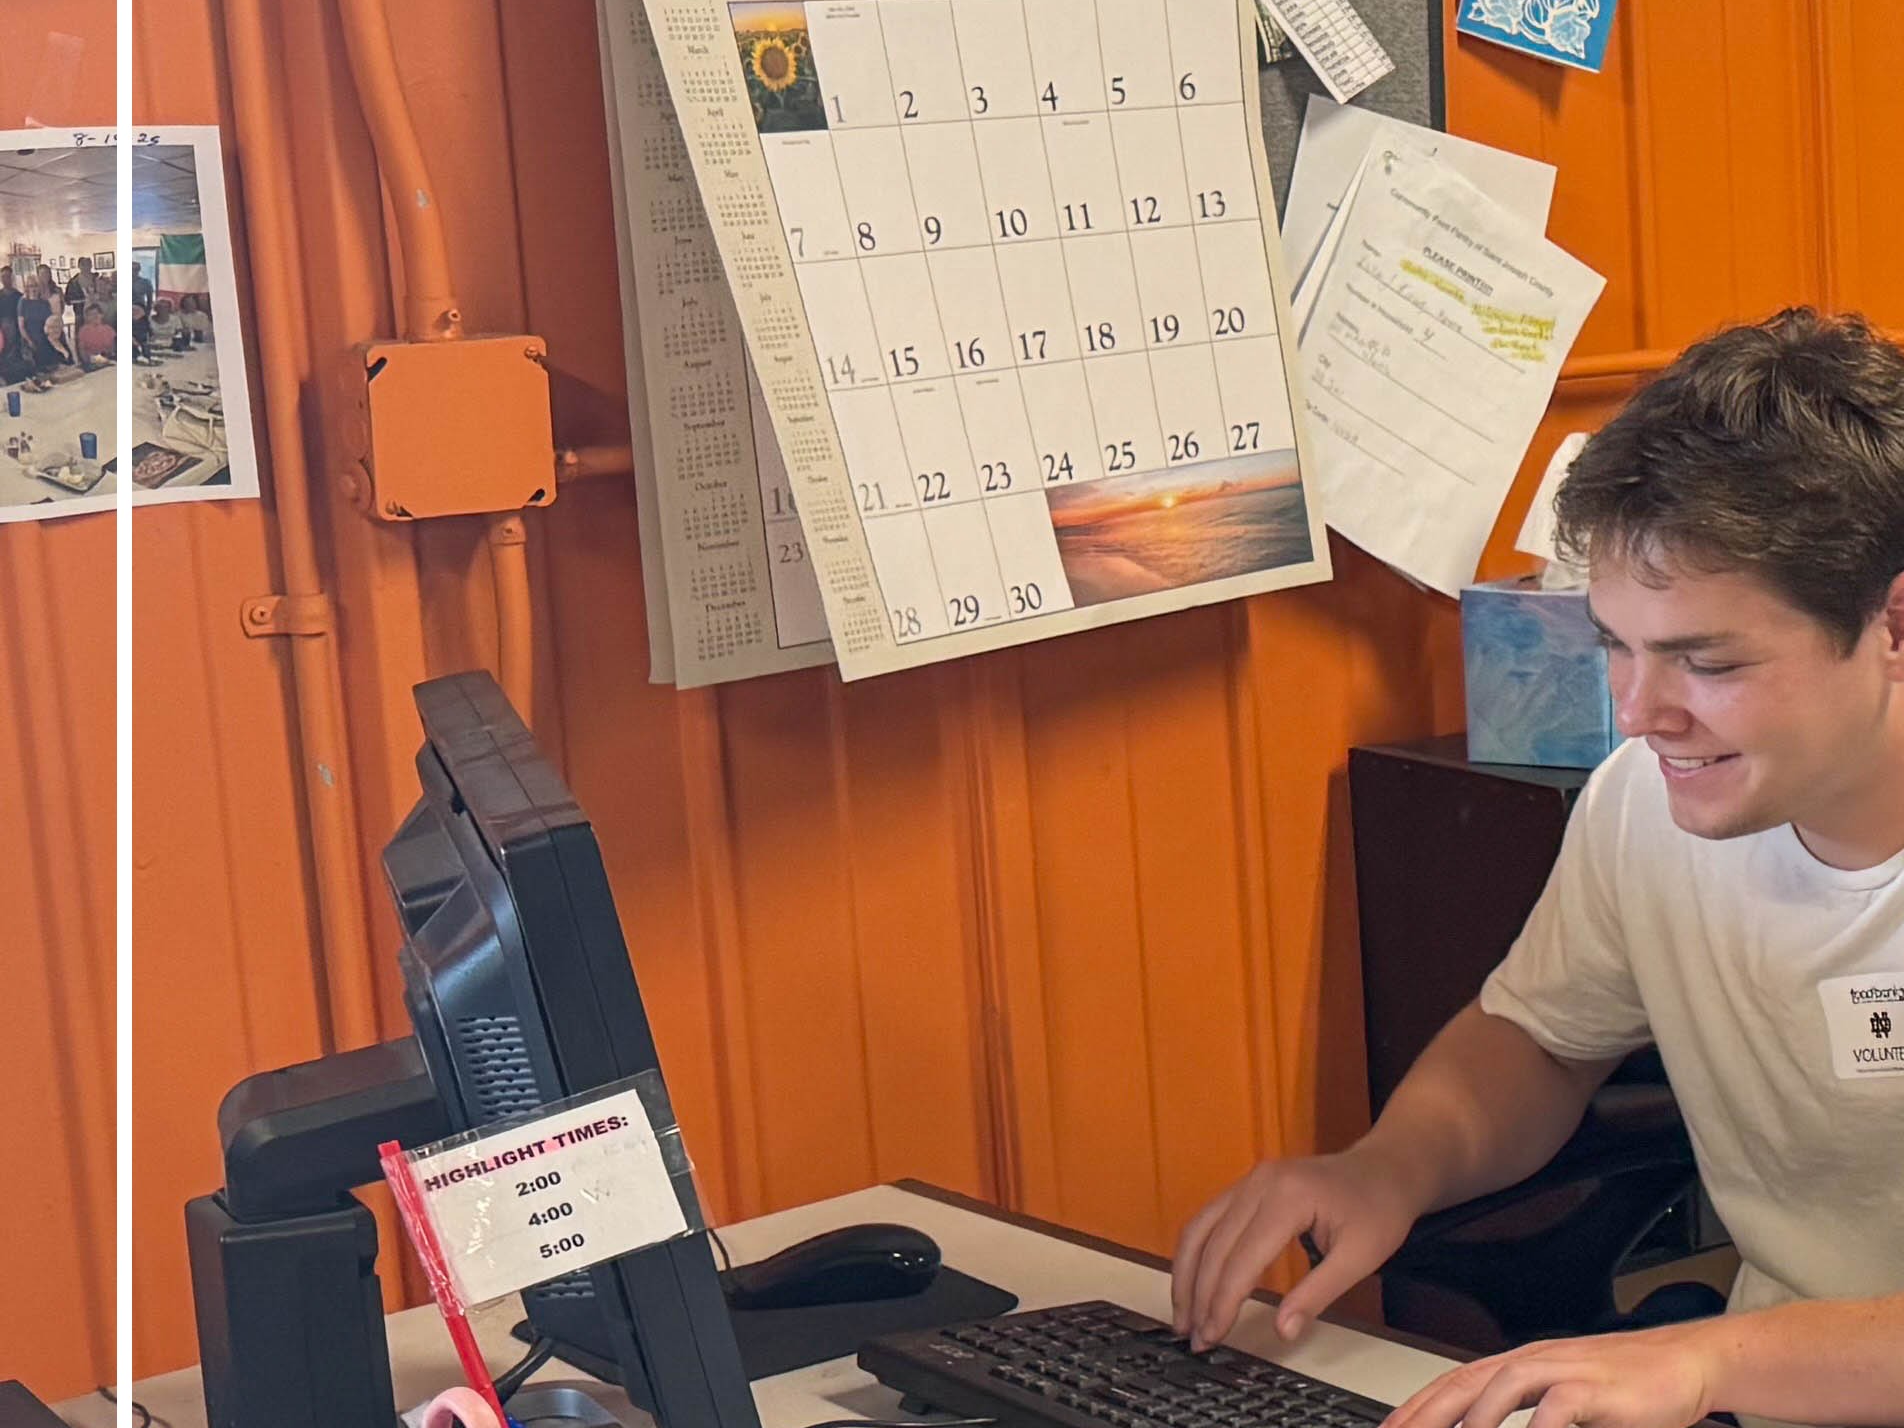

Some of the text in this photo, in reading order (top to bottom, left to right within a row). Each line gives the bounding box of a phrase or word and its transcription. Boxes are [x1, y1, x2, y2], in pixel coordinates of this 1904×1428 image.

[830, 71, 1197, 124] 1 2 3 4 5 6
[789, 189, 1227, 259] 7 8 9 10 11 12 13
[826, 306, 1247, 386] 14 15 16 17 18 19 20
[858, 421, 1262, 514] 21 22 23 24 25 26 27
[778, 541, 805, 564] 23
[893, 581, 1044, 640] 28 29 30
[423, 1114, 630, 1193] HIGHLIGHT TIMES:
[515, 1170, 562, 1198] 2:00
[527, 1201, 574, 1228] 4:00
[538, 1232, 586, 1260] 5:00
